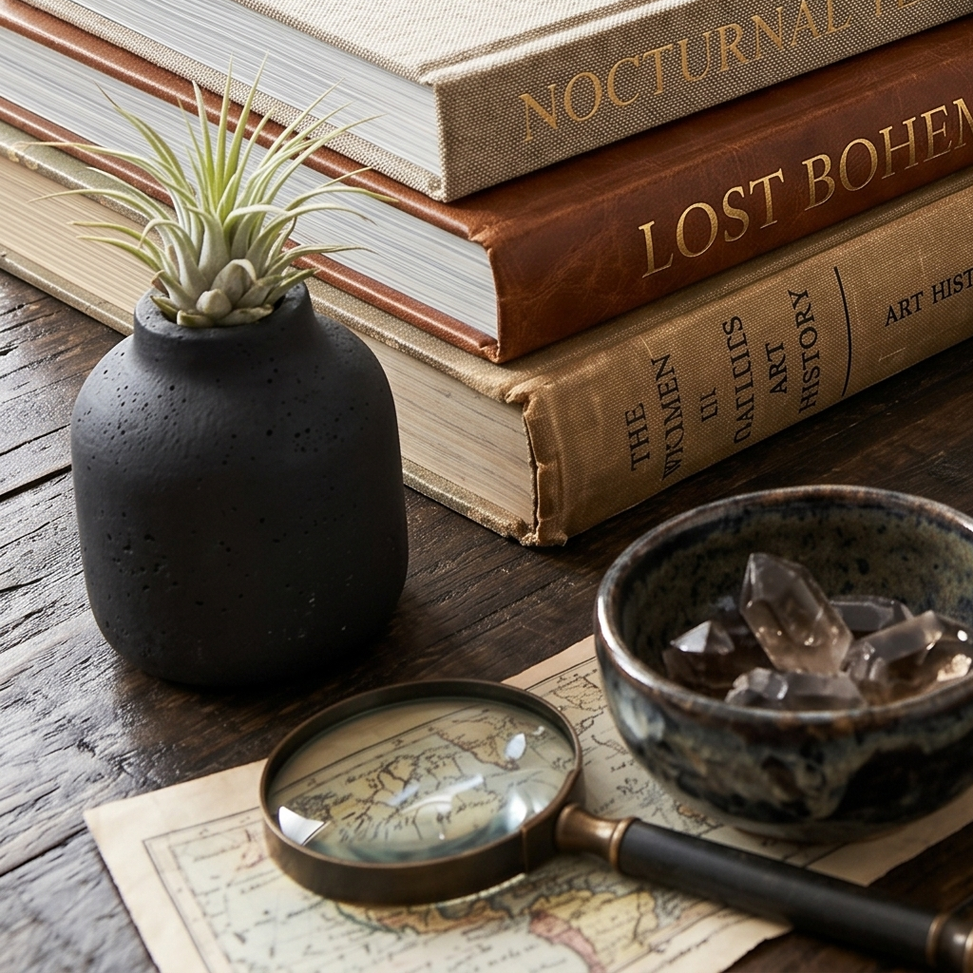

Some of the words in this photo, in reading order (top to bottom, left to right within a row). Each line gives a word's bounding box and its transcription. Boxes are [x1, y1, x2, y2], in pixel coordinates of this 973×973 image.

[637, 168, 786, 279] LOST
[885, 290, 923, 327] ART
[765, 342, 788, 394] ART
[787, 289, 821, 414] HISTORY
[625, 402, 650, 471] THE
